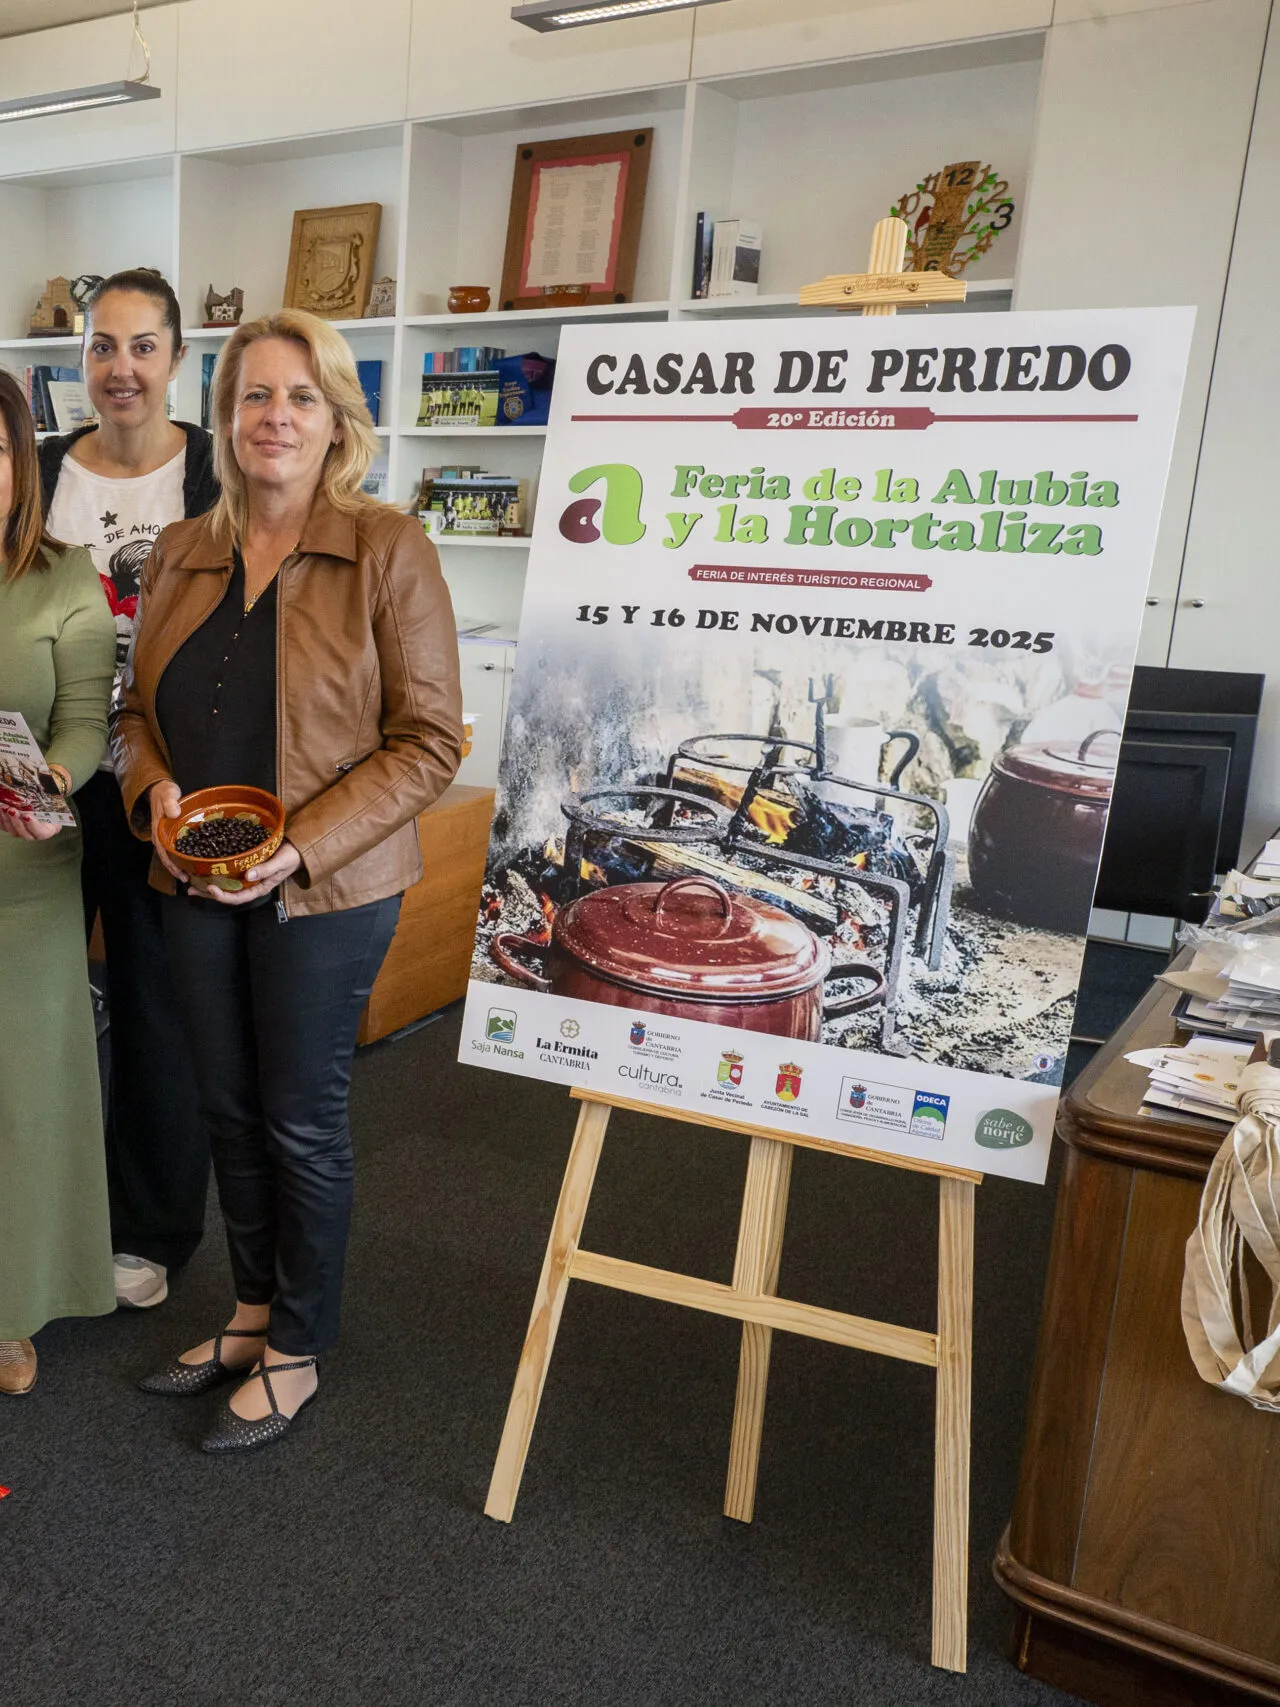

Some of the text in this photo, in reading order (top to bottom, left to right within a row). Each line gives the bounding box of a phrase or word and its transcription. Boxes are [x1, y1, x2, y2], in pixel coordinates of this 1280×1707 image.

[945, 168, 974, 187] 12
[990, 202, 1015, 230] 3
[586, 343, 1132, 396] CASAR DE PERIEDO
[808, 408, 897, 429] Edición
[670, 465, 1121, 508] Feria de la Alubia
[104, 524, 166, 544] DE AMO
[662, 504, 1104, 556] y la Hortaliza
[696, 569, 922, 590] FERIA DE INTERÉS TURÍSTICO REGIONAL
[575, 604, 1055, 654] 15 Y 16 DE NOVIEMBRE 2025
[234, 853, 259, 869] FERIA
[647, 1031, 681, 1041] GOBIERNO
[471, 1039, 525, 1060] Saja Nansa
[536, 1037, 599, 1060] La Ermita
[646, 1042, 682, 1053] CANTABRIA
[540, 1053, 591, 1071] CANTABRIA
[638, 1082, 682, 1096] cantabria
[710, 1088, 745, 1099] Junta Vecinal
[764, 1100, 800, 1111] AYUNTAMIENTO
[867, 1094, 900, 1105] GOBIERNO
[916, 1095, 946, 1106] ODECA
[865, 1106, 902, 1118] CANTABRIA
[983, 1117, 1025, 1132] sabe a
[983, 1126, 1024, 1145] norte
